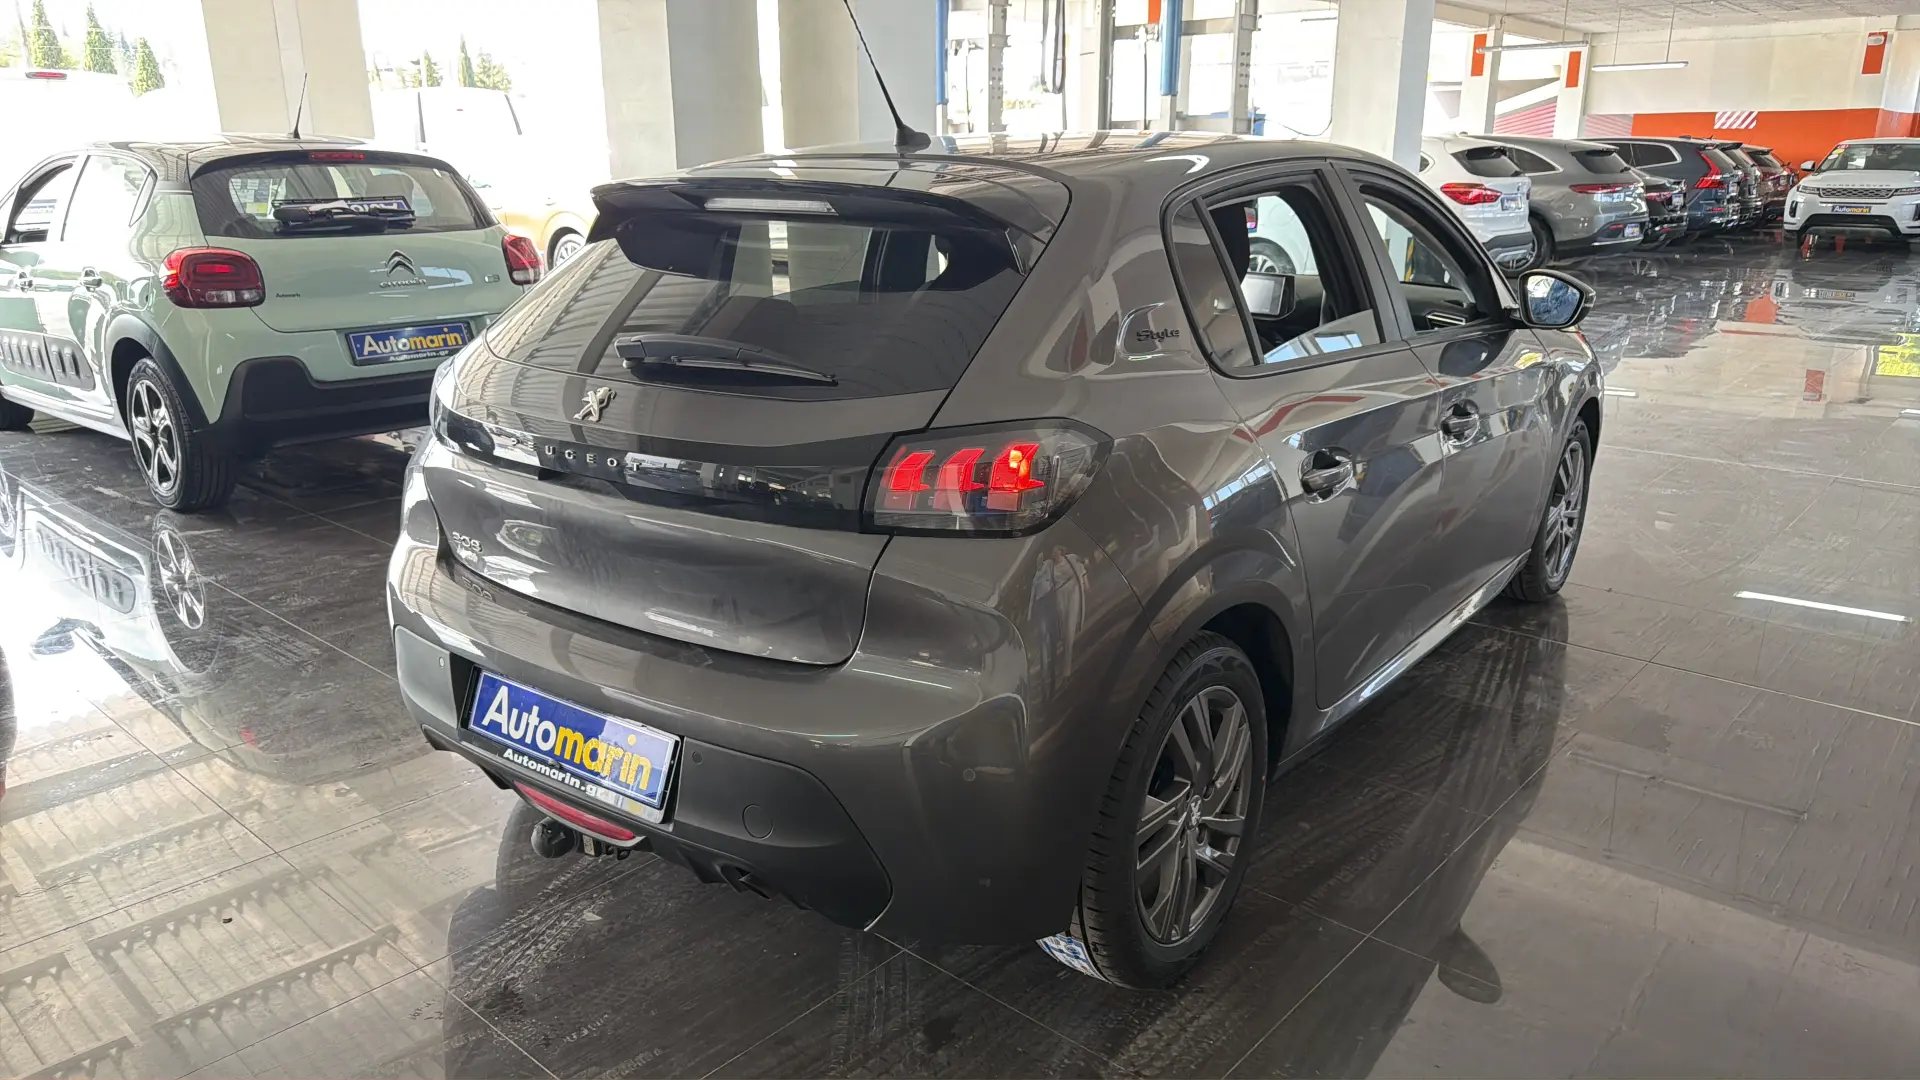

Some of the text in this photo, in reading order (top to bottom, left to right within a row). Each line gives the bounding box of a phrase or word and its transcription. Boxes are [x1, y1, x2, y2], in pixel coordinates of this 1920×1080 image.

[363, 327, 462, 355] Automarin
[1136, 328, 1180, 342] Style
[511, 437, 642, 472] PEUGEOT
[452, 531, 484, 553] 208
[482, 685, 652, 791] Automarin
